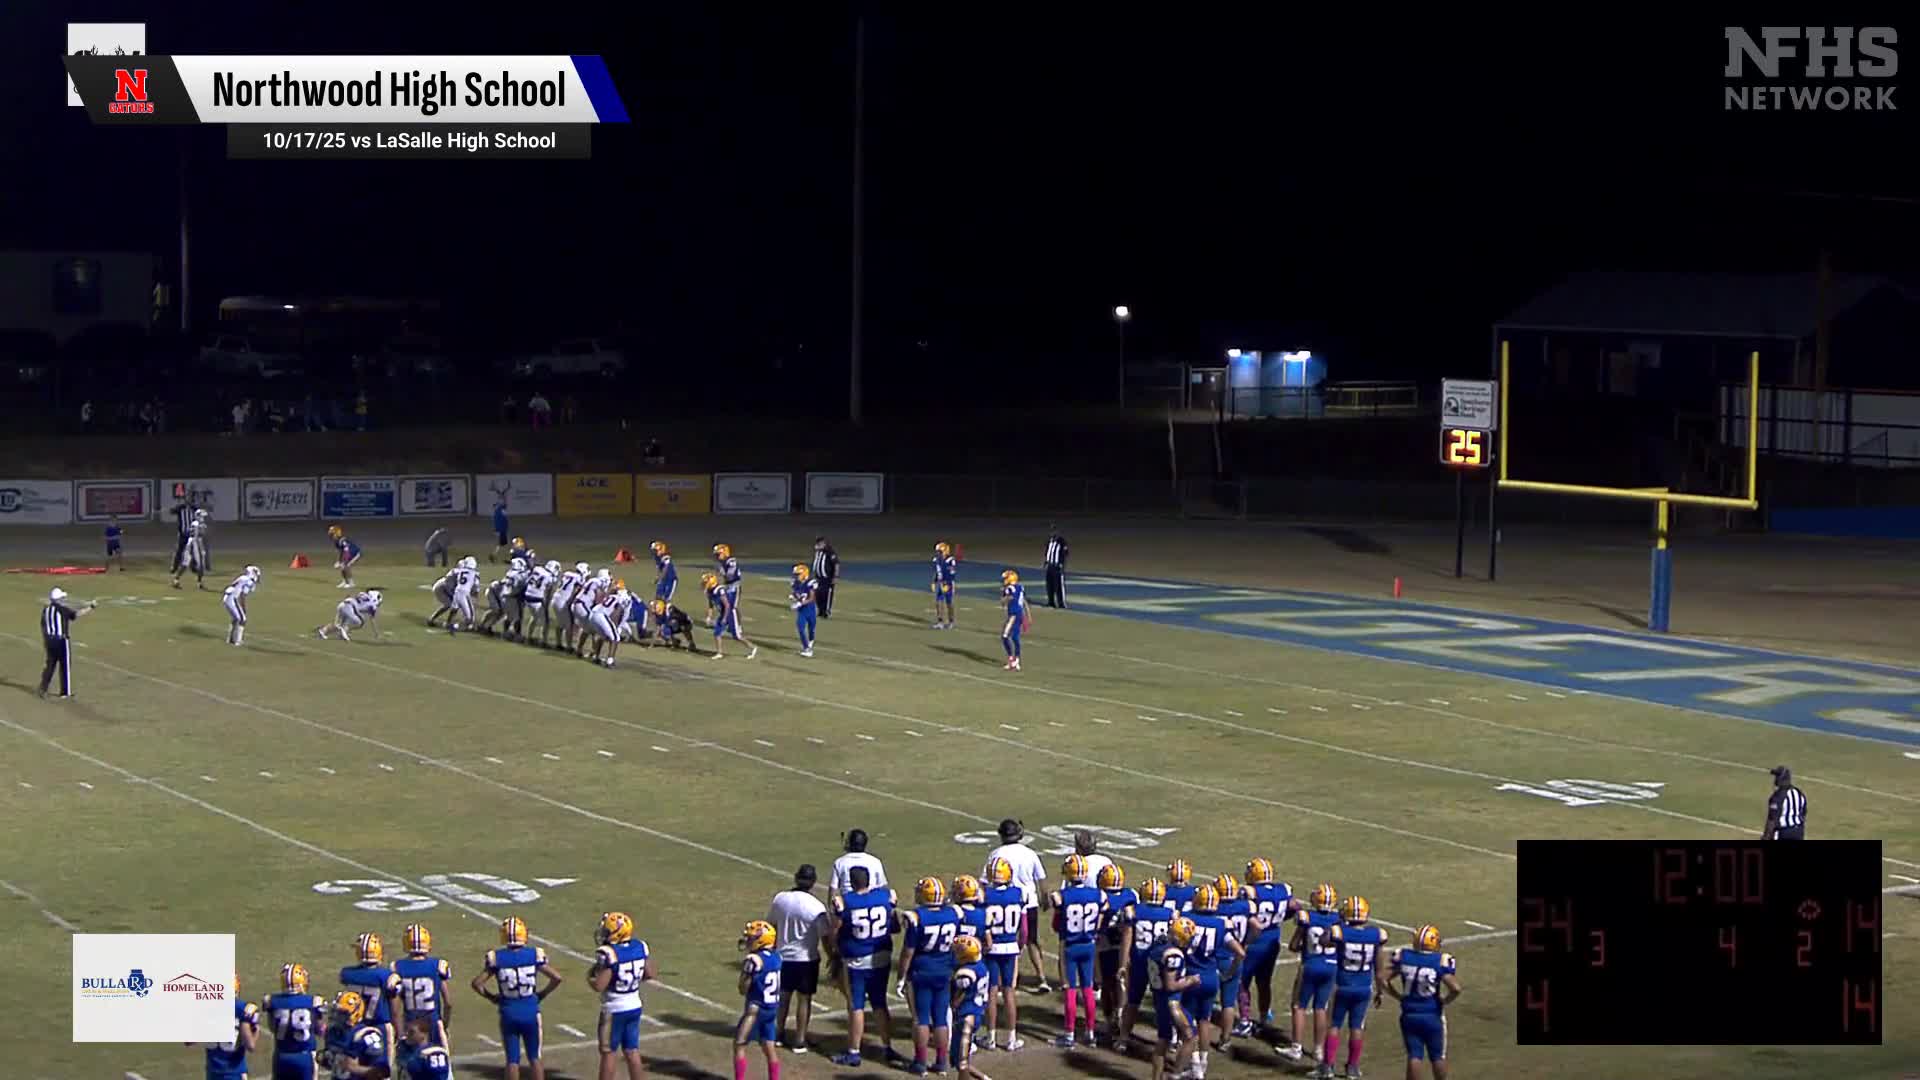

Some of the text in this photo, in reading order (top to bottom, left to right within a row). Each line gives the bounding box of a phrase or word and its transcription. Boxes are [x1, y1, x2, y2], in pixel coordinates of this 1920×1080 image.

[1450, 429, 1480, 464] 25
[1494, 779, 1660, 807] 10
[312, 873, 542, 912] 30
[1653, 850, 1763, 901] 12:00
[851, 906, 887, 939] 52
[986, 904, 1020, 935] 20
[1066, 903, 1099, 933] 82
[1523, 898, 1573, 951] 24
[1846, 897, 1879, 951] 14
[924, 923, 957, 952] 73
[1589, 930, 1605, 966] 3
[1719, 925, 1737, 968] 4
[1796, 931, 1812, 967] 2
[401, 977, 435, 1010] 12
[1526, 979, 1549, 1032] 4
[1842, 977, 1876, 1032] 14
